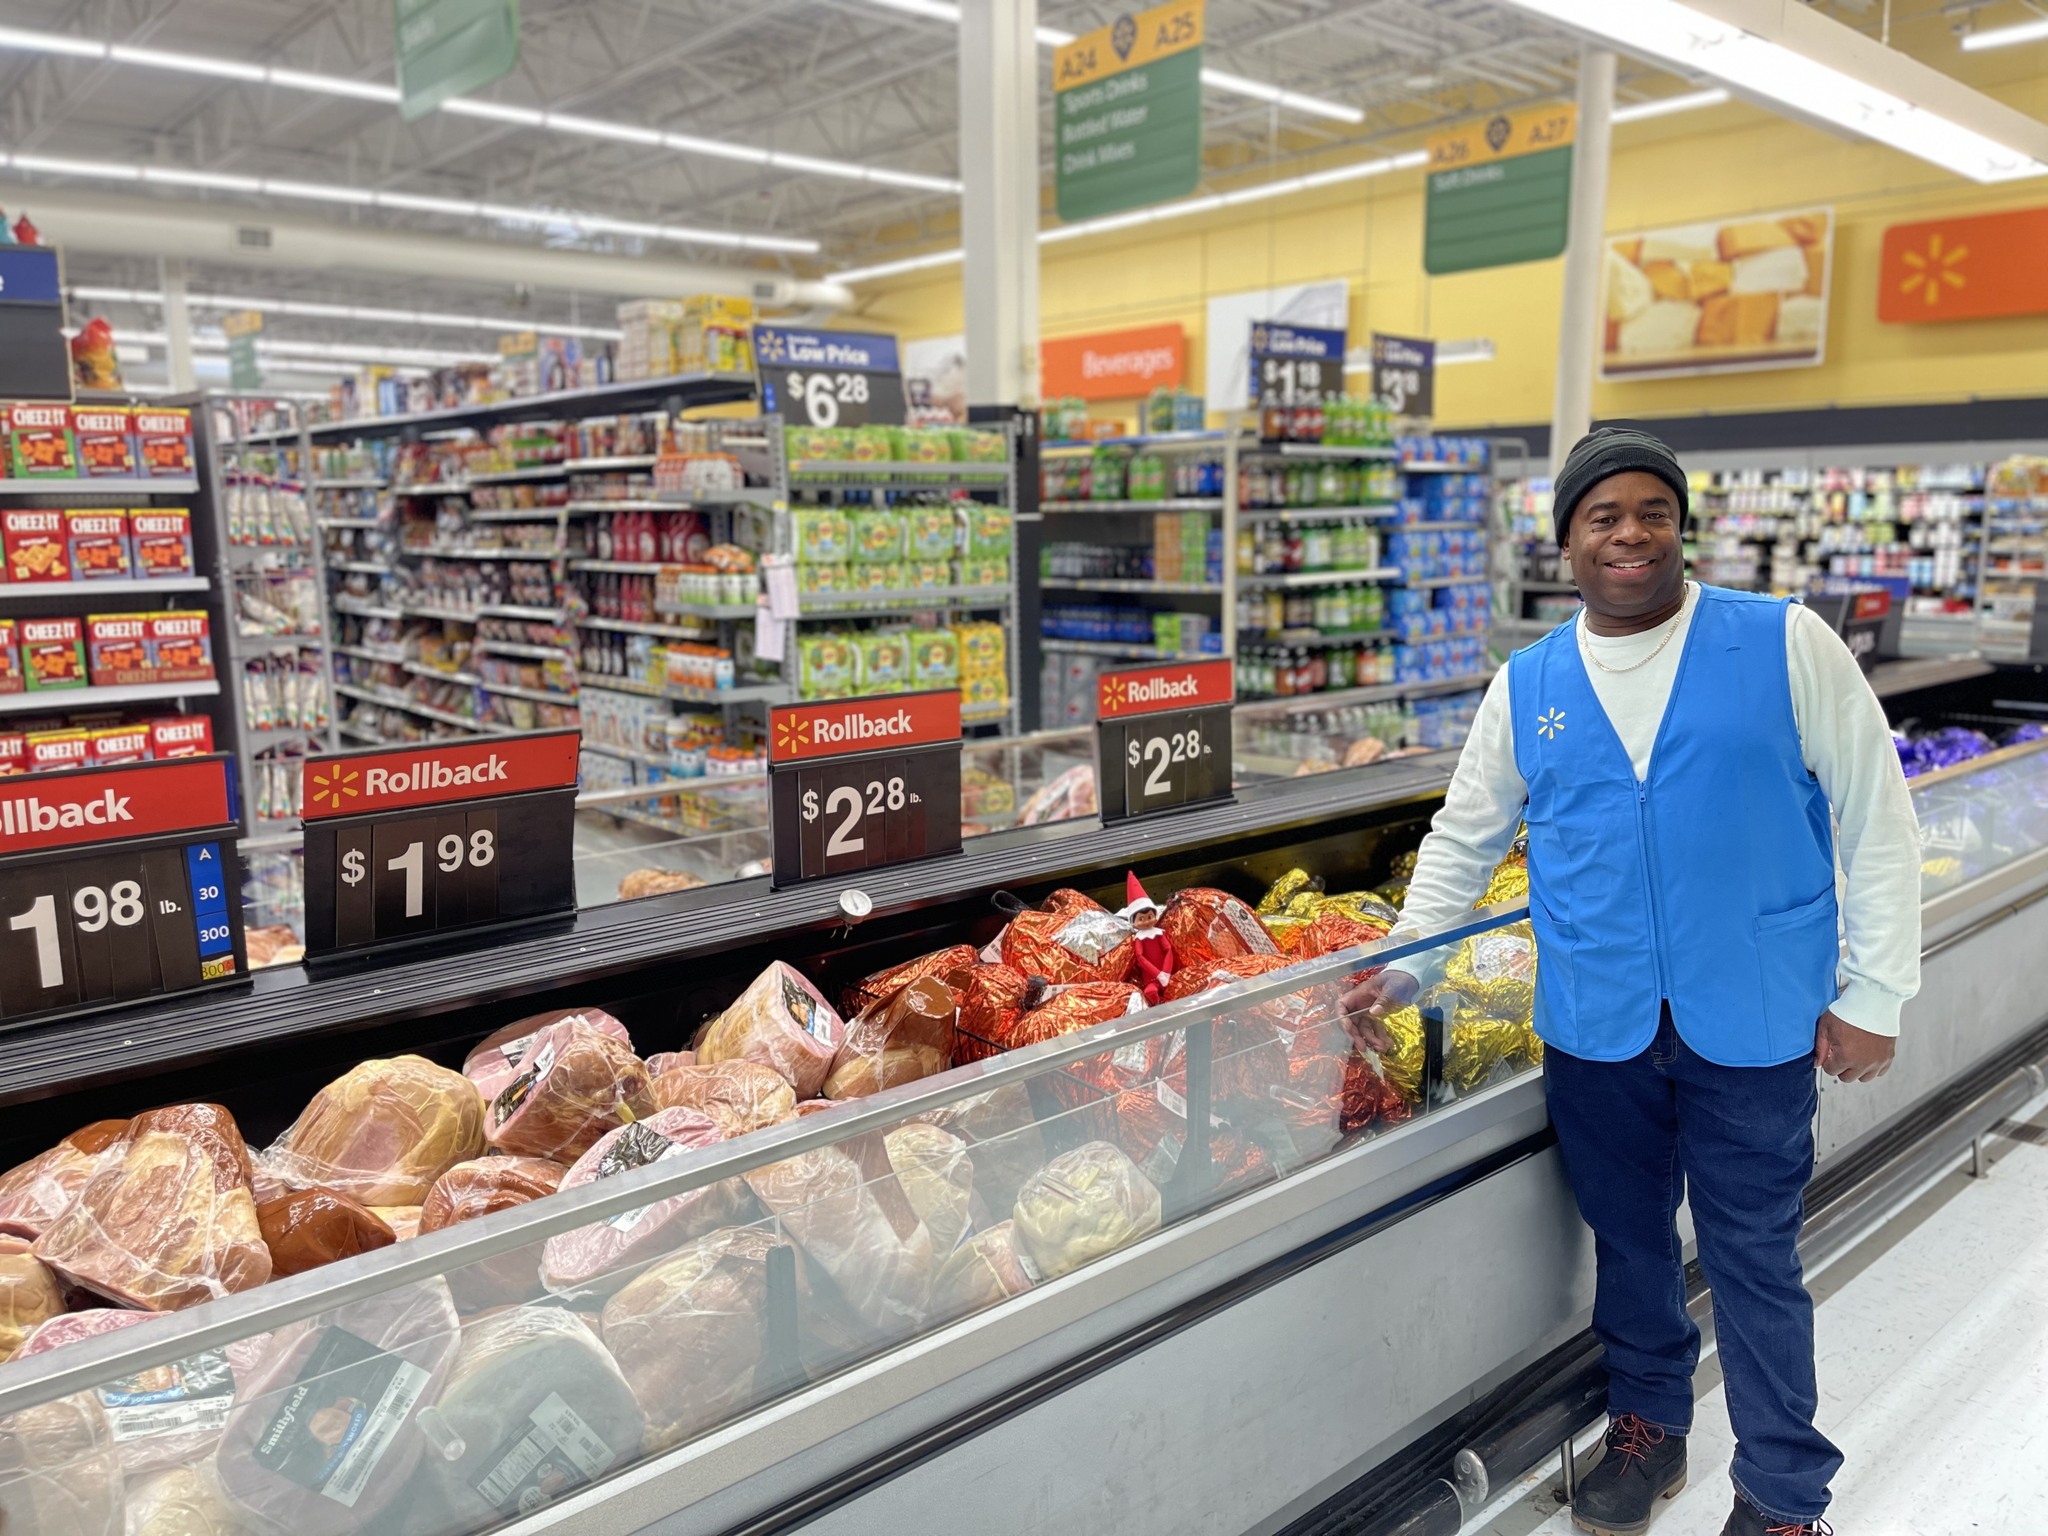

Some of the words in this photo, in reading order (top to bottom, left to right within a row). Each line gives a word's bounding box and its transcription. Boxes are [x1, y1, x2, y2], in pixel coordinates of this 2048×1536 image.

[1156, 12, 1196, 47] A25
[1061, 49, 1097, 79] A24
[1529, 117, 1568, 145] A27
[789, 343, 825, 362] Low
[826, 343, 870, 366] Price
[1082, 347, 1174, 379] Beverages
[1127, 674, 1199, 703] Rollback
[813, 709, 913, 744] Rollback
[365, 754, 508, 796] Rollback
[0, 788, 133, 836] llback
[909, 792, 922, 803] lb.
[199, 848, 212, 861] A
[159, 900, 182, 914] lb.
[199, 886, 219, 900] 30
[200, 925, 229, 942] 300
[260, 1385, 309, 1455] Smithfield
[346, 1412, 363, 1442] SMOKED
